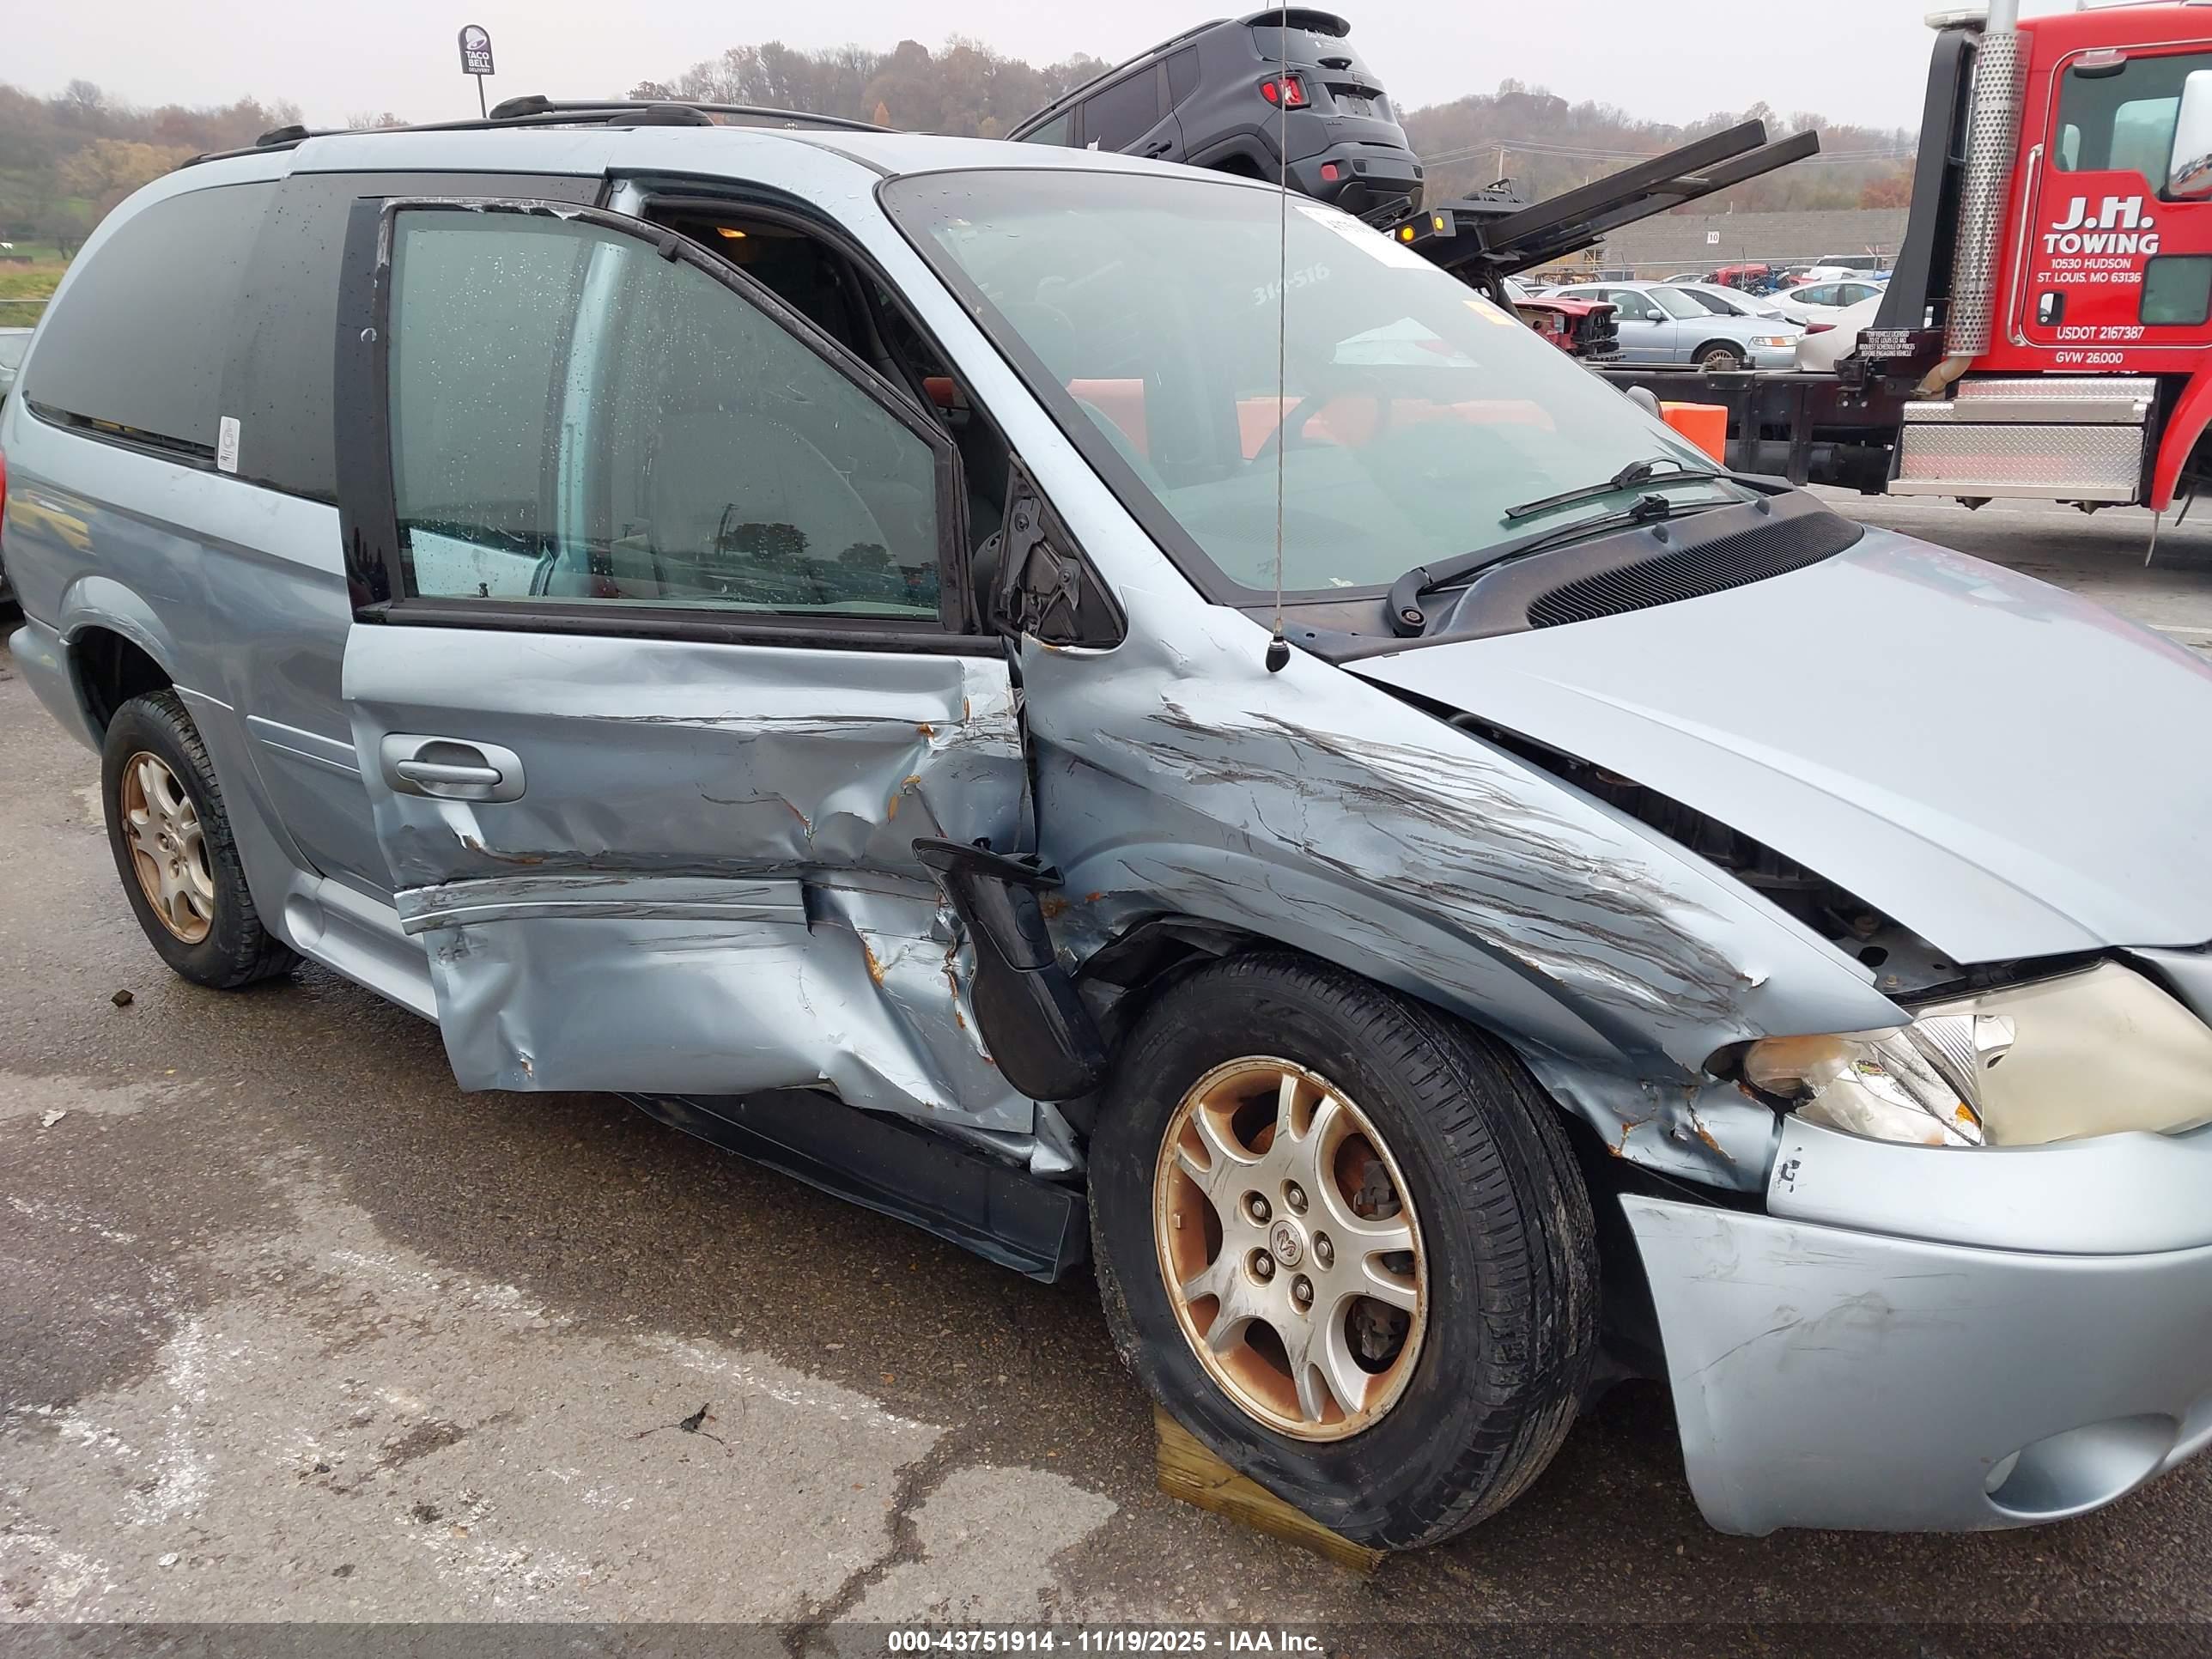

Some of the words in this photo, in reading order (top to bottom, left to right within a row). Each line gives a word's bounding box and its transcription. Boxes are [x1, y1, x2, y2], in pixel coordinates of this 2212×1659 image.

[465, 51, 489, 59] TACO
[468, 59, 490, 68] BELL
[2051, 196, 2154, 230] J.H.
[2043, 233, 2160, 254] TOWING
[2051, 258, 2081, 269] 10530
[2084, 258, 2131, 269] HUDSON
[2037, 272, 2051, 283] ST.
[2090, 272, 2108, 282] MO
[2111, 272, 2142, 283] 63136
[2057, 326, 2097, 339] USDOT
[2100, 326, 2145, 339] 2167387
[2056, 352, 2084, 363] GVW
